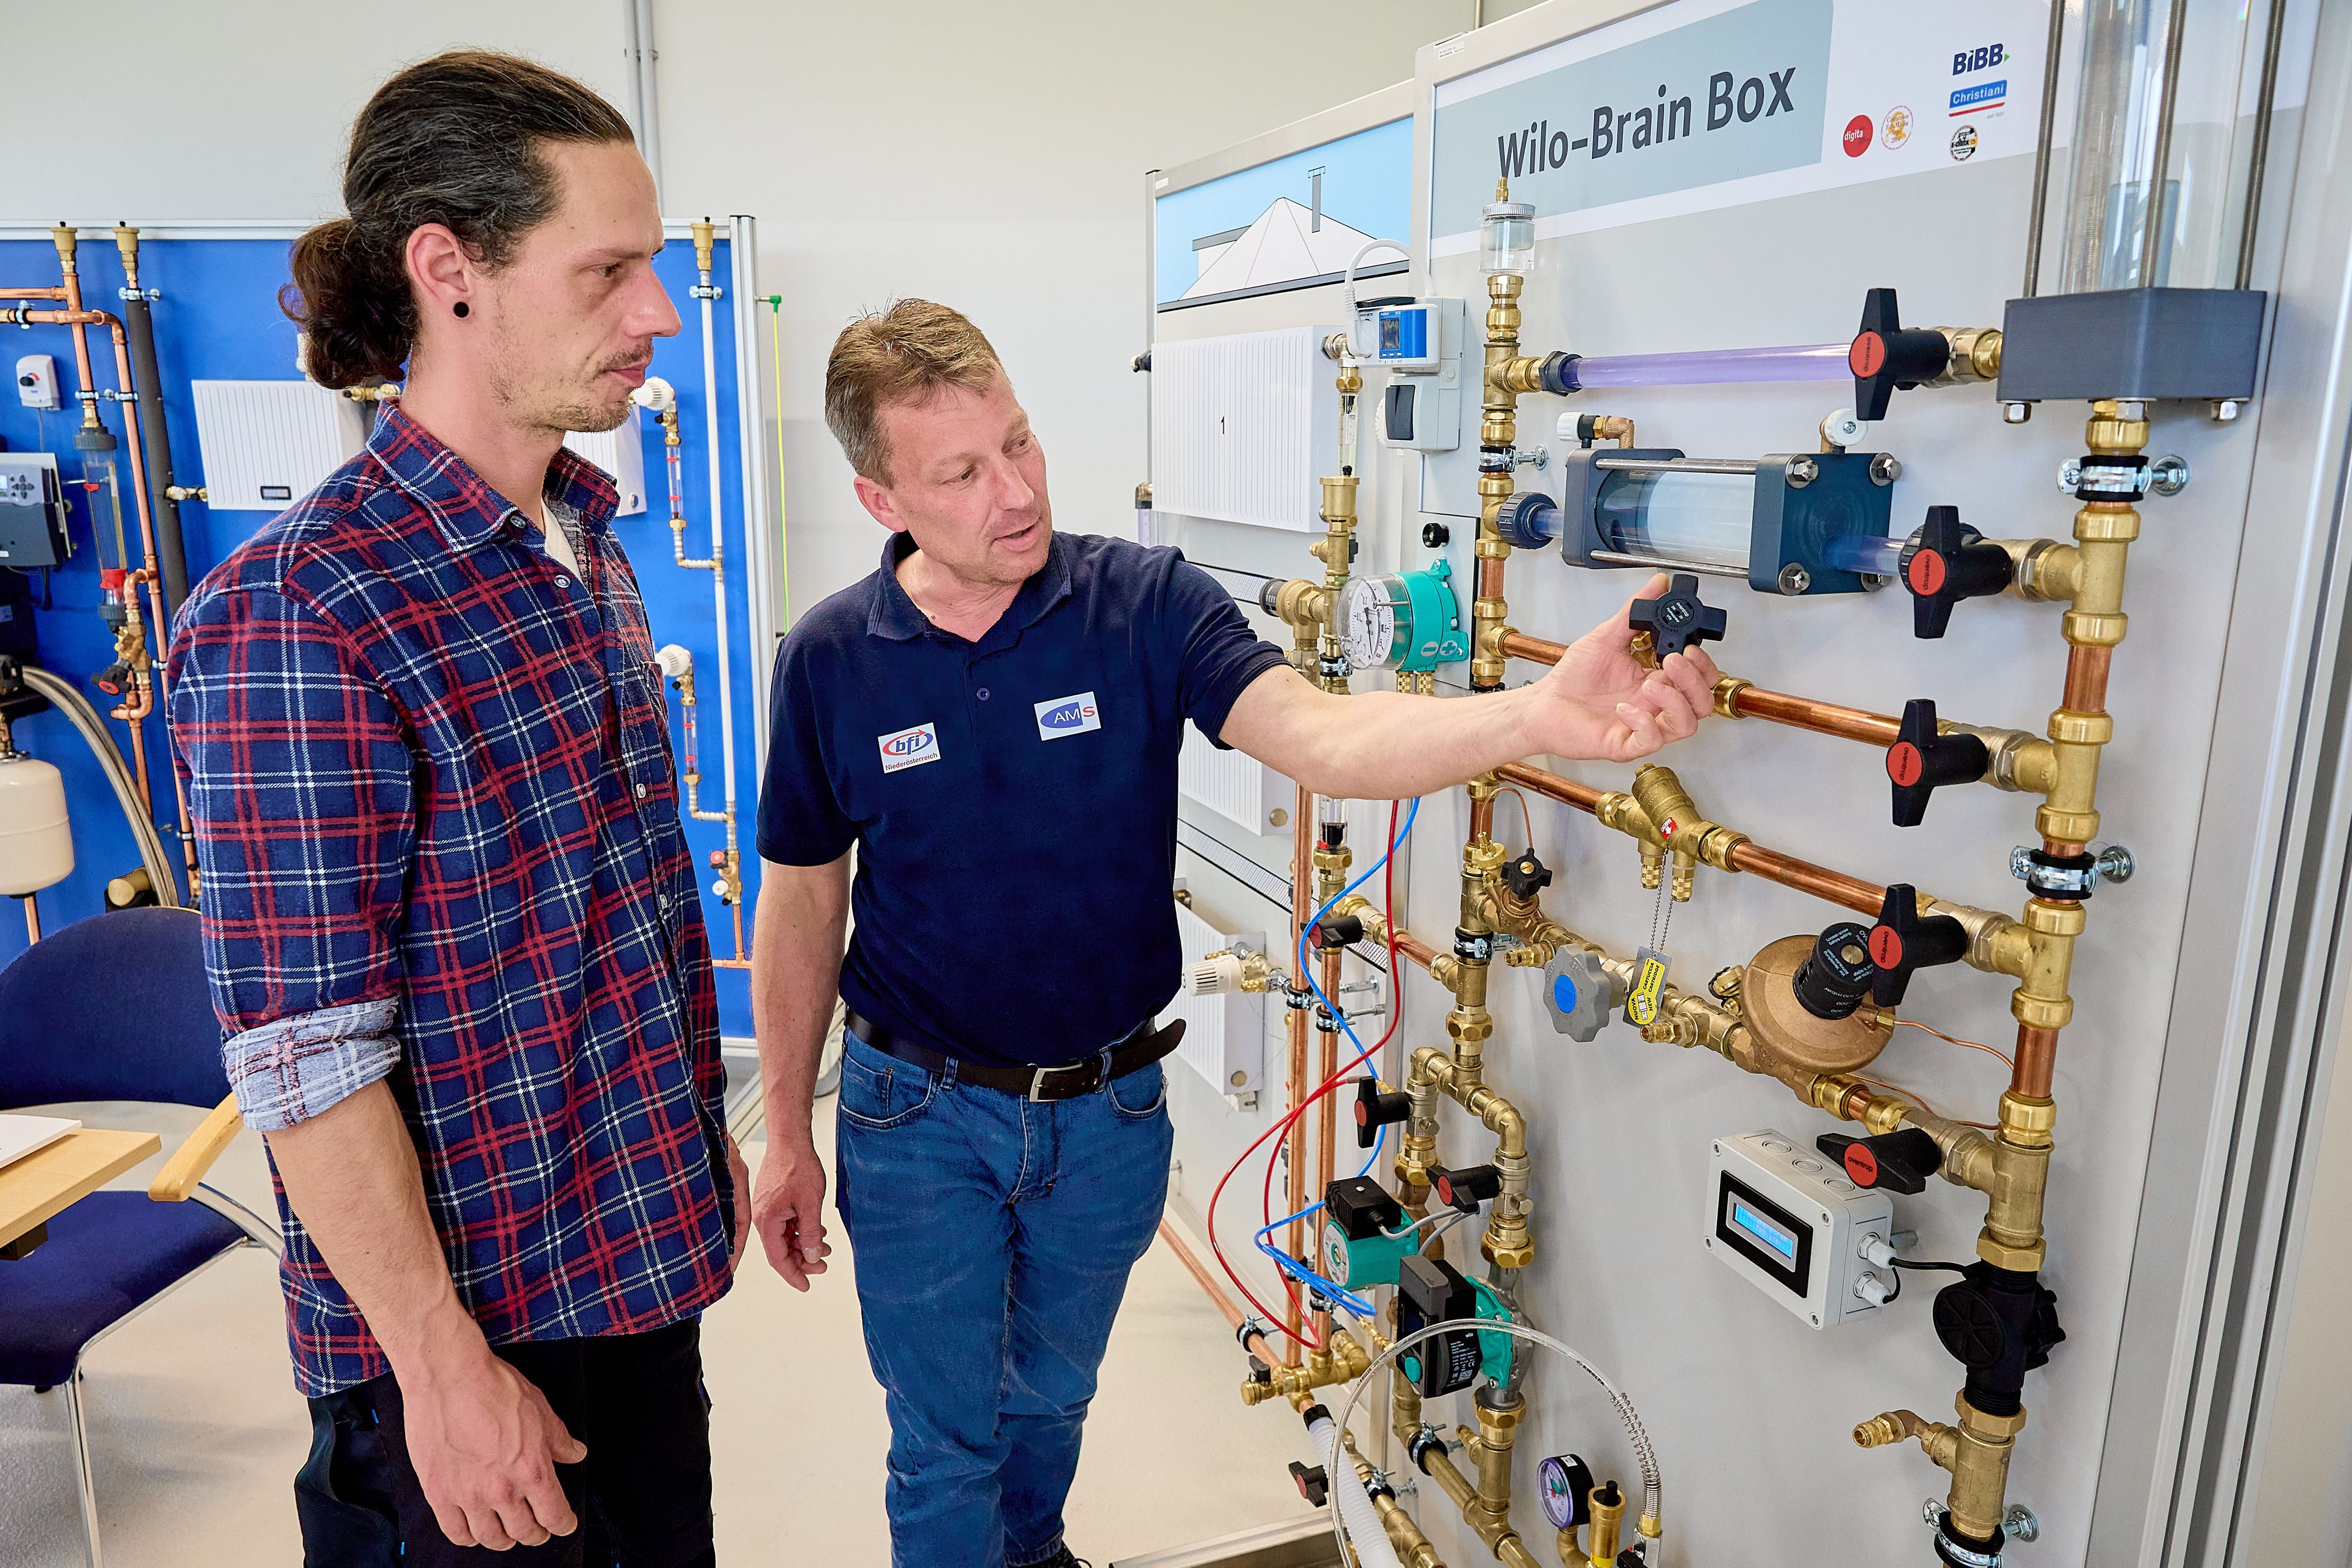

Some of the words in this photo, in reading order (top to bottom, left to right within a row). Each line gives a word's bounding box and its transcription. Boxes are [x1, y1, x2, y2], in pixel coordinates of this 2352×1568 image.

[1953, 84, 2004, 104] Christiani
[1498, 84, 1692, 178] Wilo-Brain
[1706, 67, 1796, 131] Box
[1845, 129, 1863, 142] digita
[1863, 337, 1872, 372] oventrop
[1676, 602, 1689, 617] oventrop
[1054, 706, 1095, 724] AMS
[896, 735, 920, 755] bfi
[885, 753, 938, 771] Niederösterreich
[1899, 747, 1909, 781] oventrop
[1661, 818, 1672, 833] CALEFFI
[1825, 932, 1839, 942] Loosen
[1880, 931, 1889, 963] oventrop
[1643, 962, 1654, 990] CARTUCCIA
[1648, 965, 1659, 992] CARTRIDGE
[1824, 987, 1843, 997] mbar
[1847, 1156, 1873, 1172] oventrop
[1582, 1365, 1605, 1386] RIEGLER
